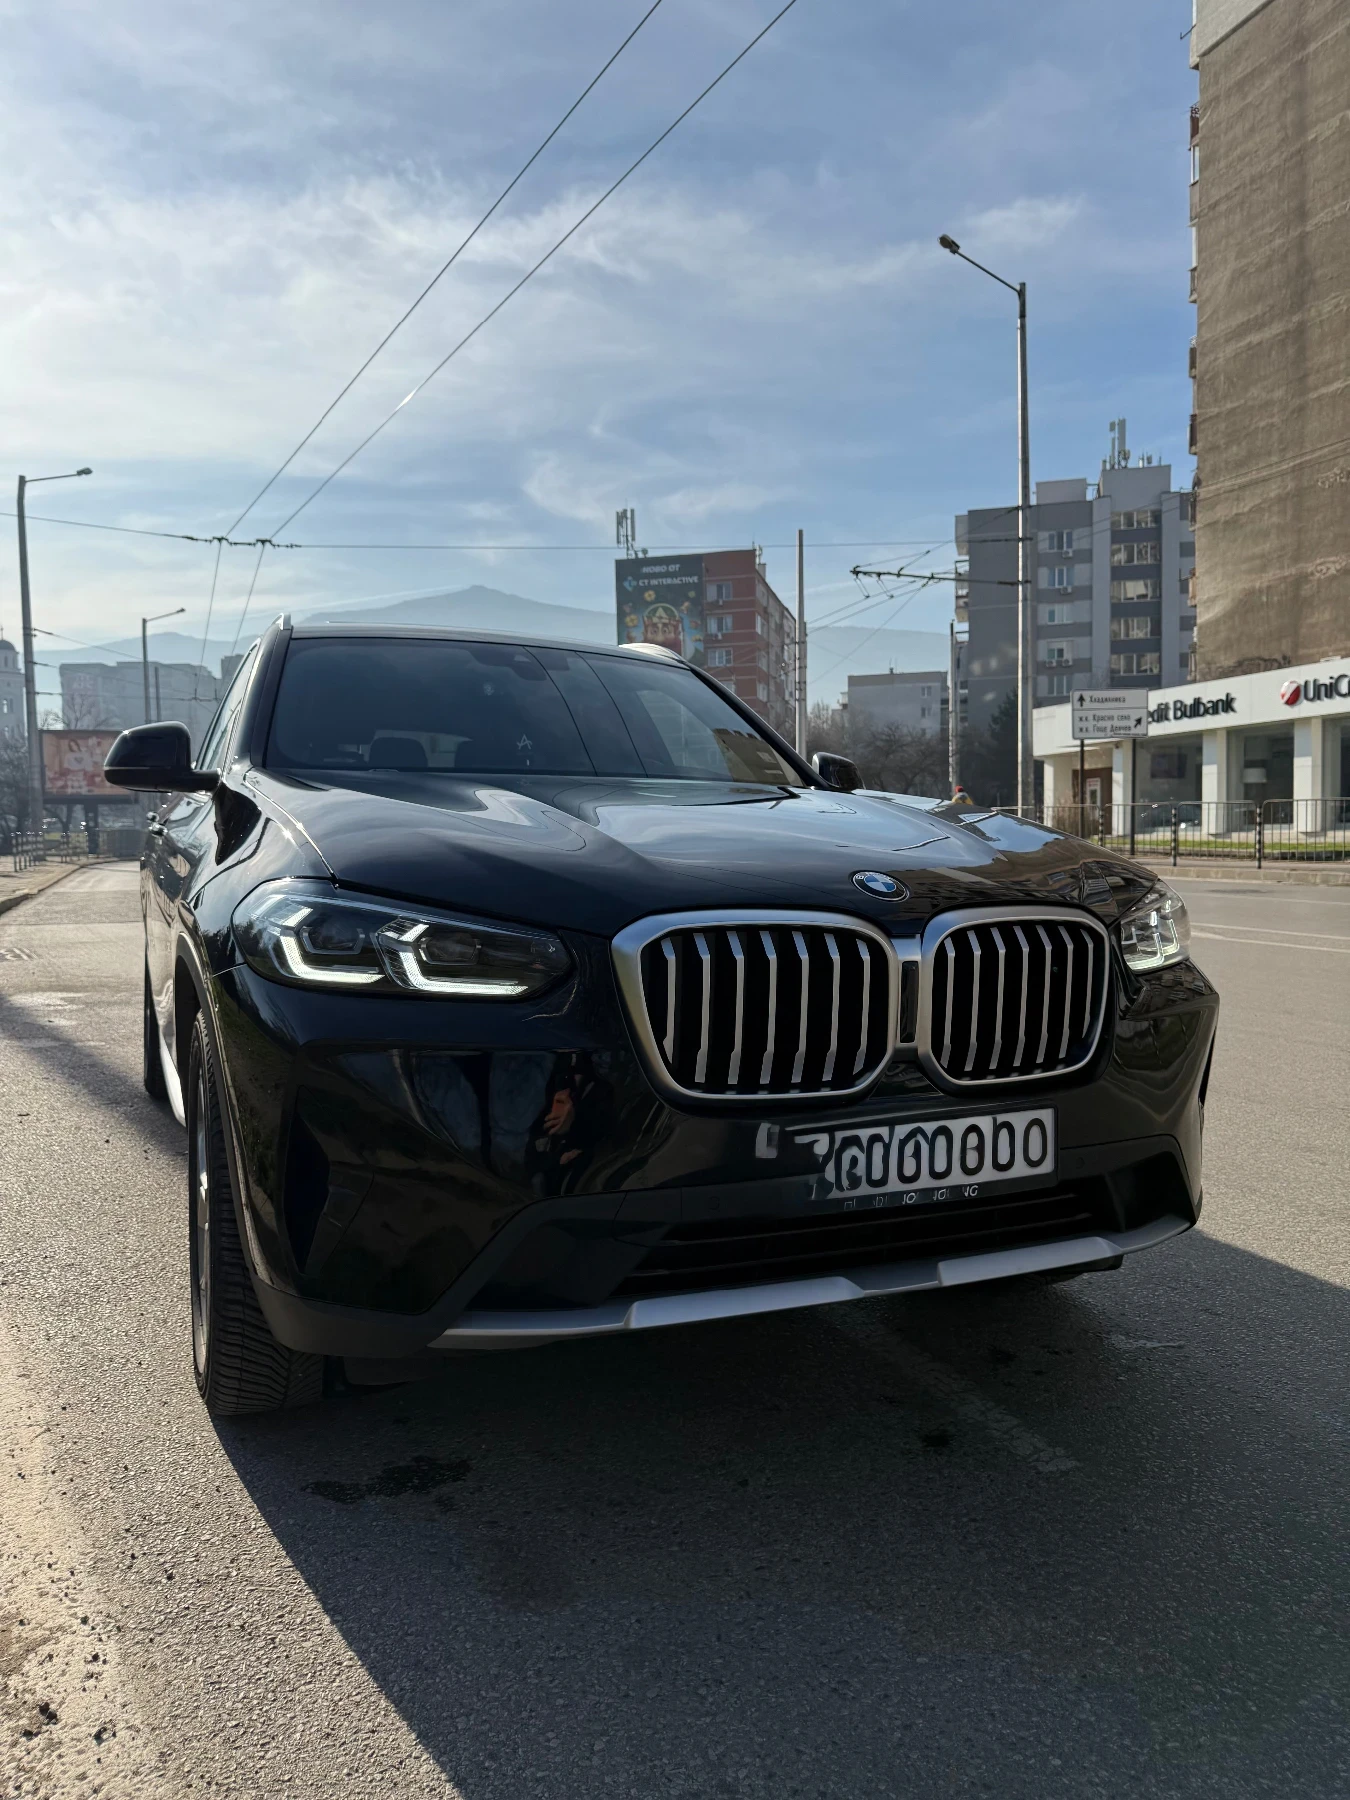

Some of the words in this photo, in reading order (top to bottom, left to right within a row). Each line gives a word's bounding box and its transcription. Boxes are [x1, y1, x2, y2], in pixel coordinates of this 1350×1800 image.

[642, 565, 668, 573] НОВО
[668, 563, 681, 572] ОТ
[649, 576, 699, 586] INTERACTIVE
[1173, 692, 1237, 720] Bulbank
